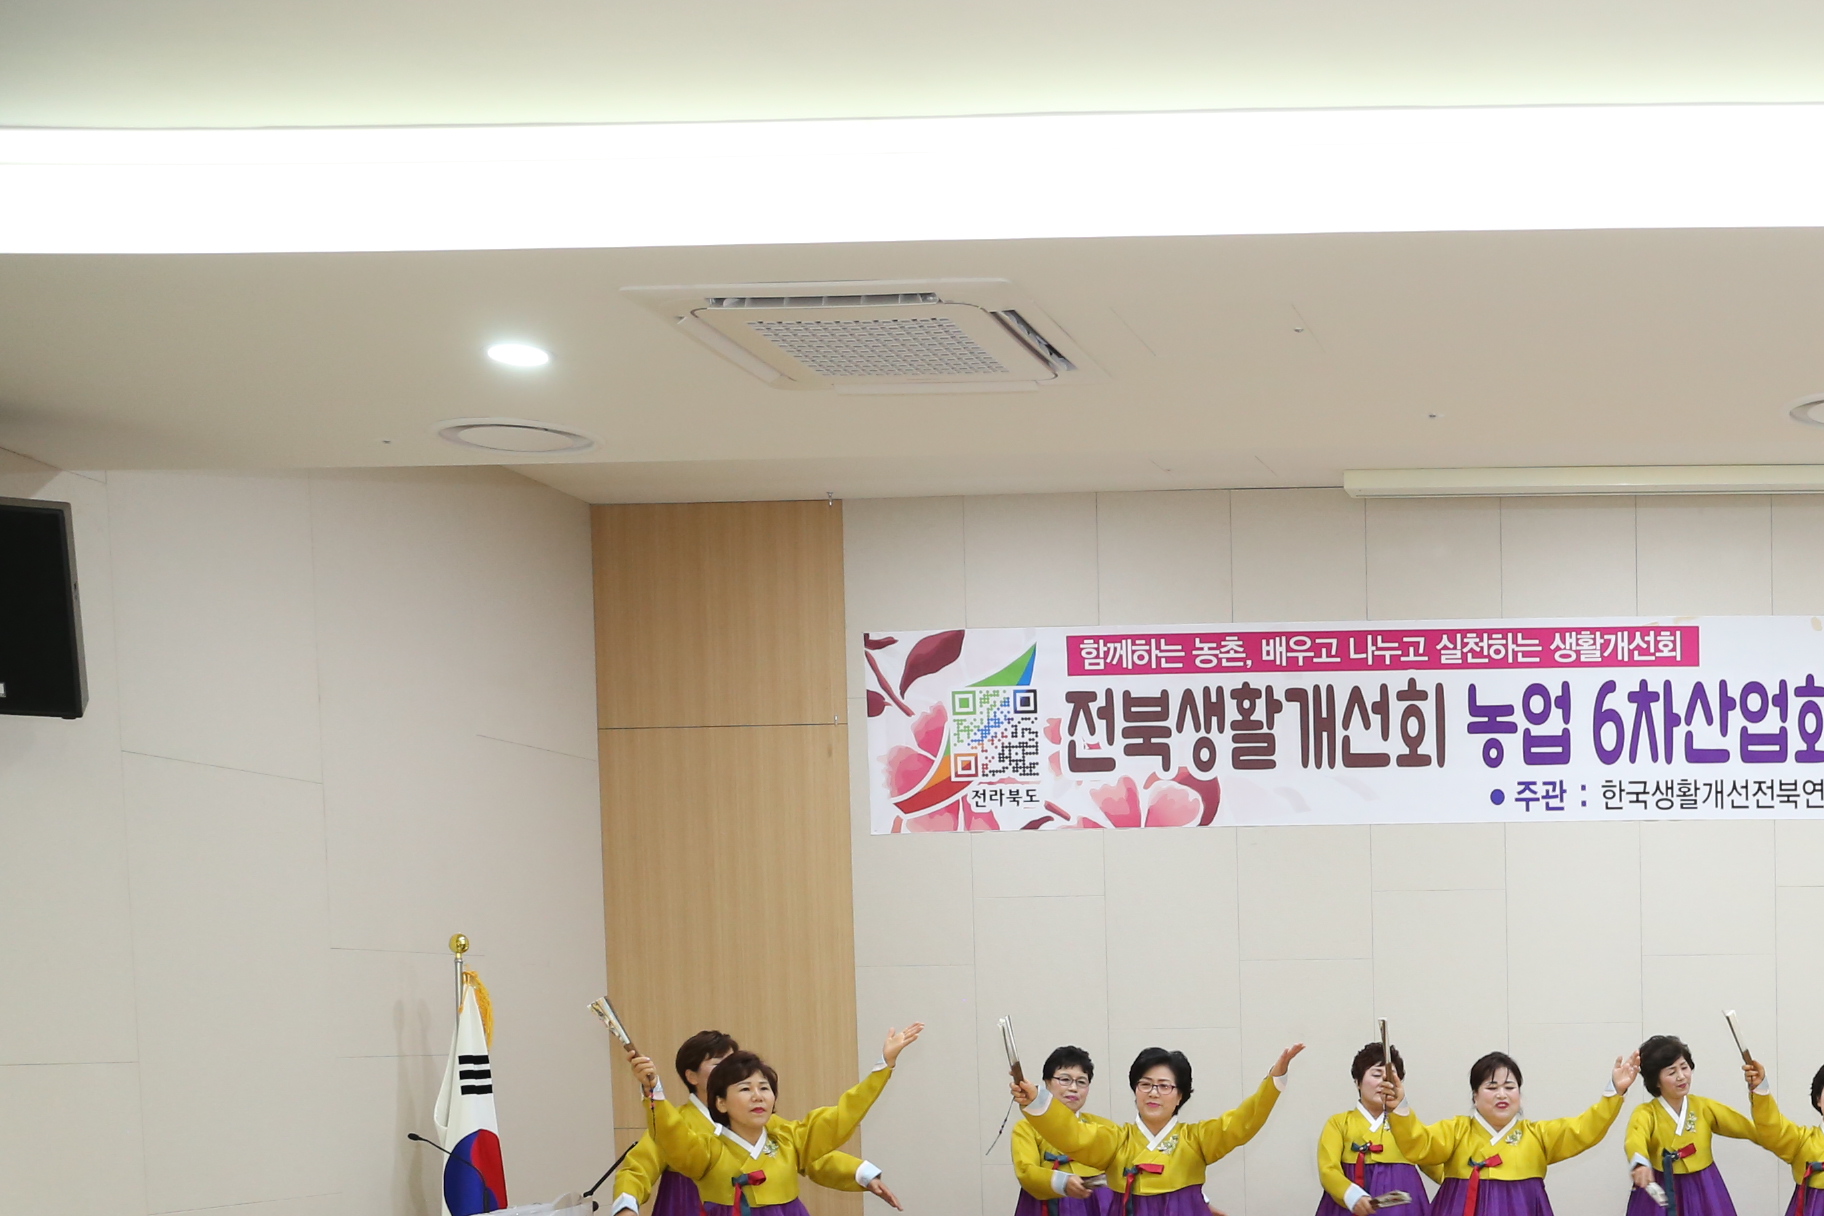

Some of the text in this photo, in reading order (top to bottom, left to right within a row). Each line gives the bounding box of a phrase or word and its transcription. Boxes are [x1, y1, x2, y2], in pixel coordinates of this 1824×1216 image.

[1079, 629, 1683, 670] 함께하는 농촌, 배우고 나누고 실천하는 생활개선회
[1065, 677, 1446, 774] 전북생활개선회
[1466, 680, 1572, 769] 농업
[970, 788, 1040, 809] 전라북도
[1514, 779, 1567, 813] 주관
